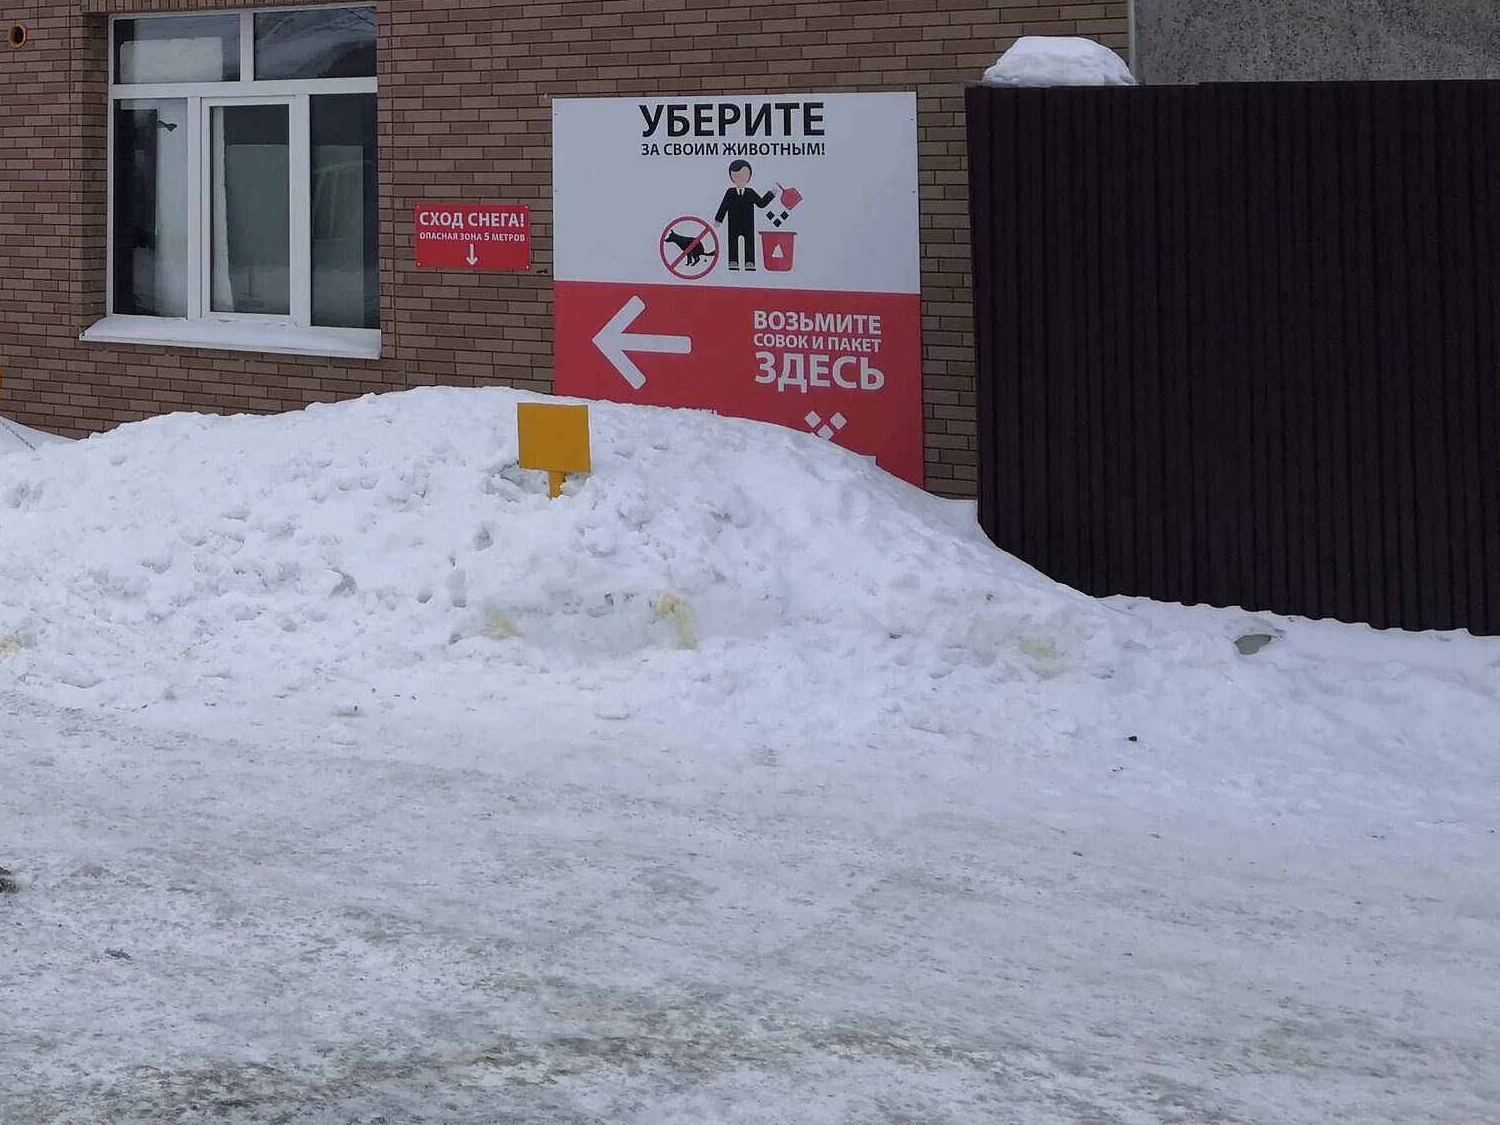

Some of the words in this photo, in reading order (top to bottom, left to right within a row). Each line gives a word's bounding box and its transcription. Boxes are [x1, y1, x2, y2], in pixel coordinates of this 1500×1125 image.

[639, 102, 825, 137] УБЕРИТЕ
[641, 143, 660, 155] ЗА
[663, 142, 719, 155] СВОИМ
[722, 142, 826, 155] ЖИВОТНЫМ!
[419, 211, 464, 229] СХОД
[467, 212, 525, 228] СНЕГА!
[419, 231, 458, 240] ОПАСНАЯ
[459, 232, 482, 241] ЗОНА
[483, 232, 490, 241] 5
[491, 233, 526, 242] МЕТРОВ
[753, 310, 882, 335] ВОЗЬМИТЕ
[753, 333, 809, 349] СОВОК
[812, 336, 824, 350] И
[827, 336, 882, 353] ПАКЕТ
[754, 351, 885, 393] ЗДЕСЬ
